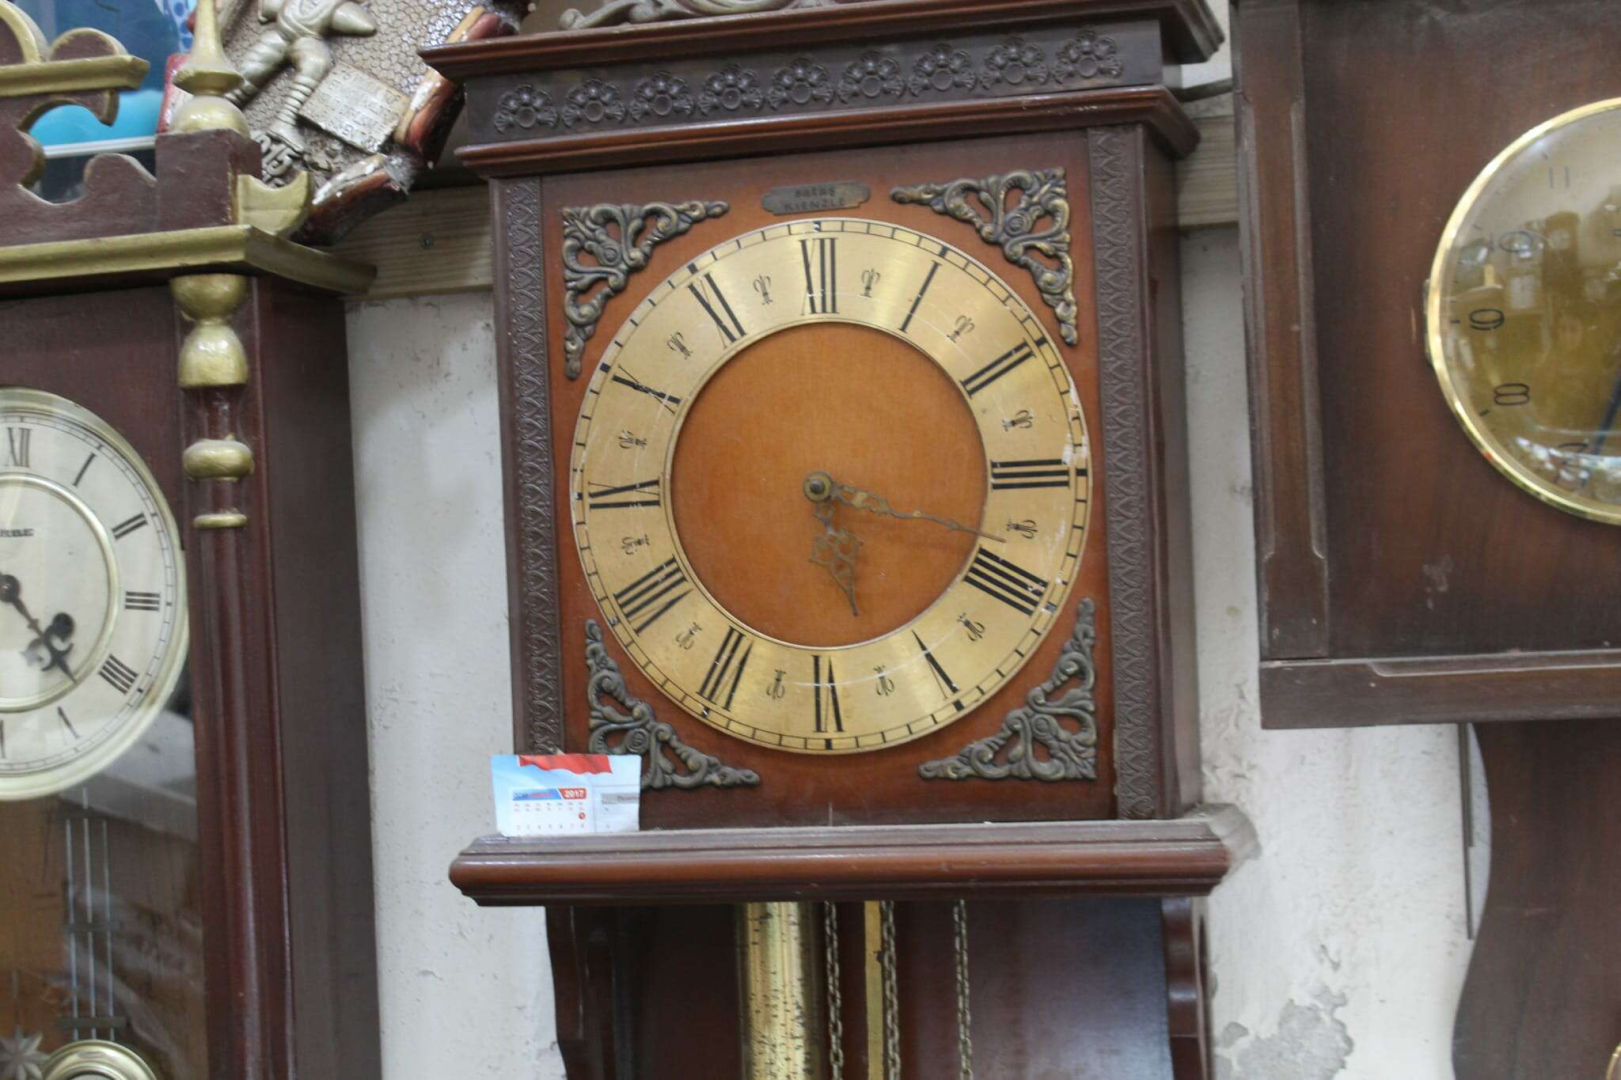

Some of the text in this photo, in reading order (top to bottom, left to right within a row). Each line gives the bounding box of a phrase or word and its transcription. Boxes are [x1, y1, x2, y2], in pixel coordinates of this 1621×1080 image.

[800, 236, 839, 315] XII
[686, 271, 748, 349] XI
[1468, 307, 1505, 331] 9
[611, 364, 682, 414] X
[960, 337, 1036, 399] II
[1493, 382, 1531, 406] 8
[7, 426, 32, 469] XII
[588, 477, 662, 510] IX
[990, 457, 1071, 492] III
[111, 511, 149, 541] II
[124, 590, 161, 612] III
[613, 555, 692, 636] VIII
[962, 545, 1049, 617] IIII
[98, 652, 140, 696] IIII
[696, 625, 754, 712] VII
[911, 629, 960, 700] V
[811, 653, 844, 733] VI
[564, 789, 585, 799] 2017
